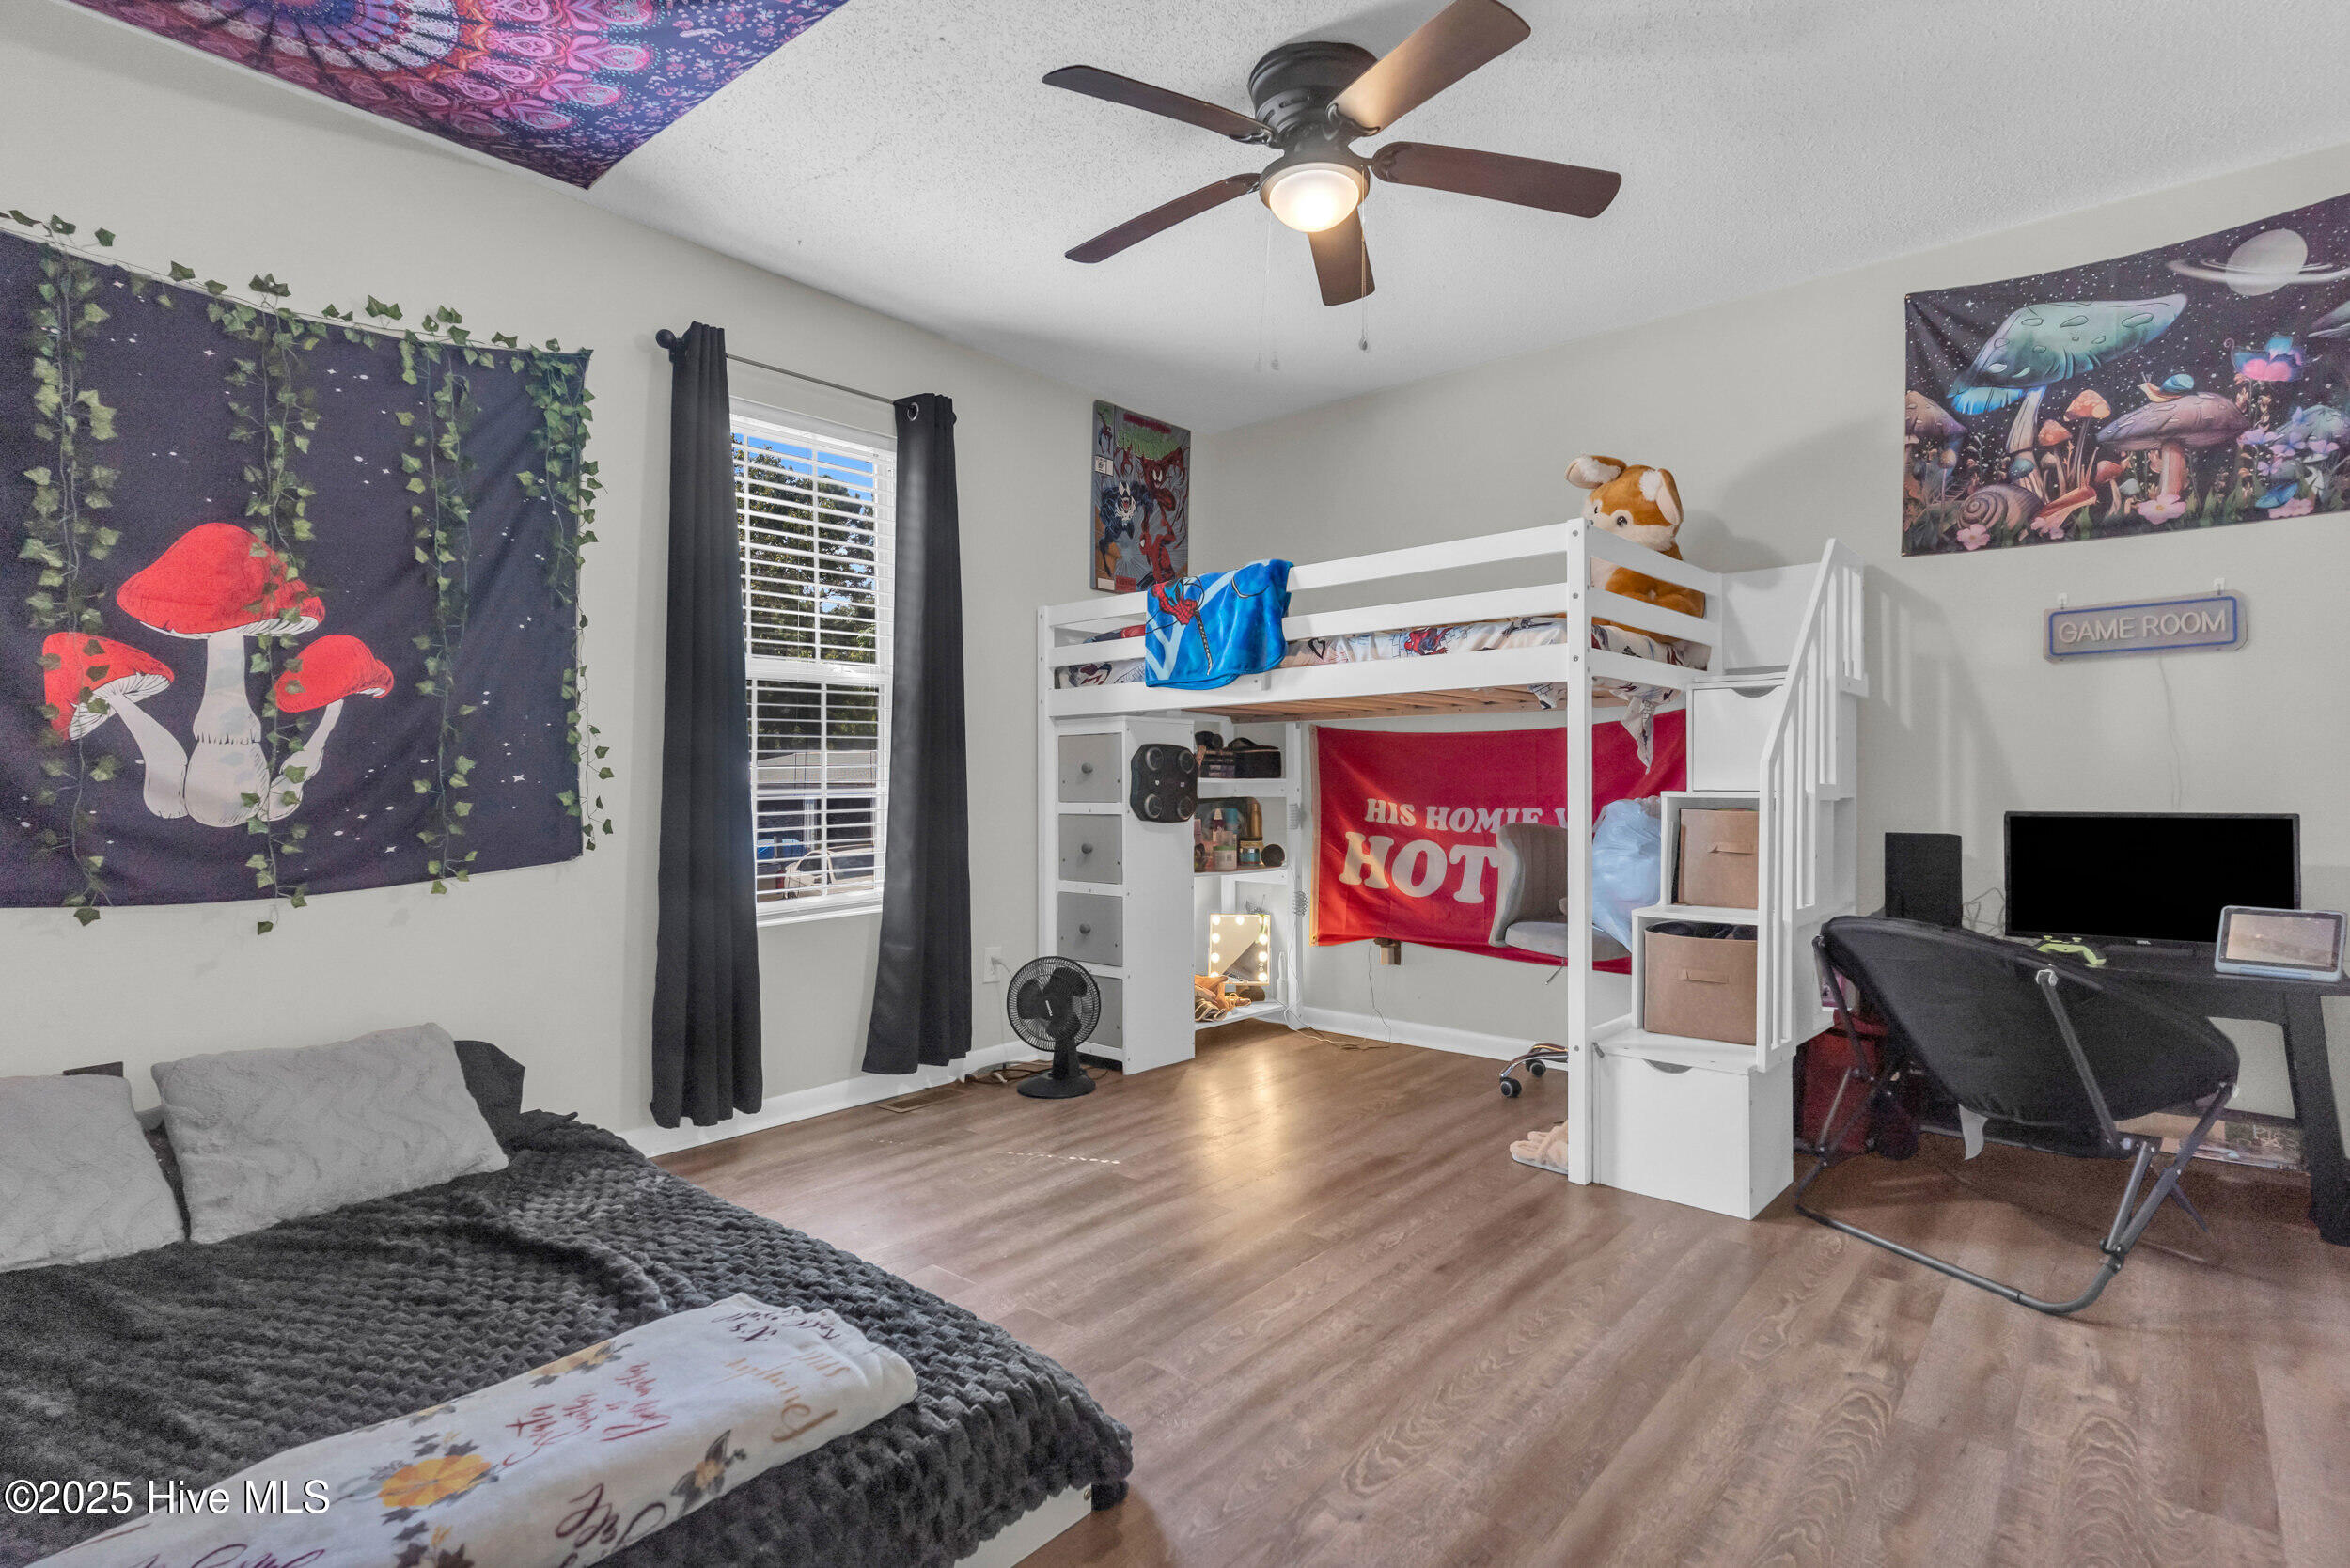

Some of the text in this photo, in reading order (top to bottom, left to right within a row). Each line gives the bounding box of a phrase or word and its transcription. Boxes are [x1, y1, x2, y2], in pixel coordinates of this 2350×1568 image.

[2059, 610, 2226, 644] GAME ROOM
[1364, 798, 1417, 827] HIS
[1339, 831, 1499, 903] HOT
